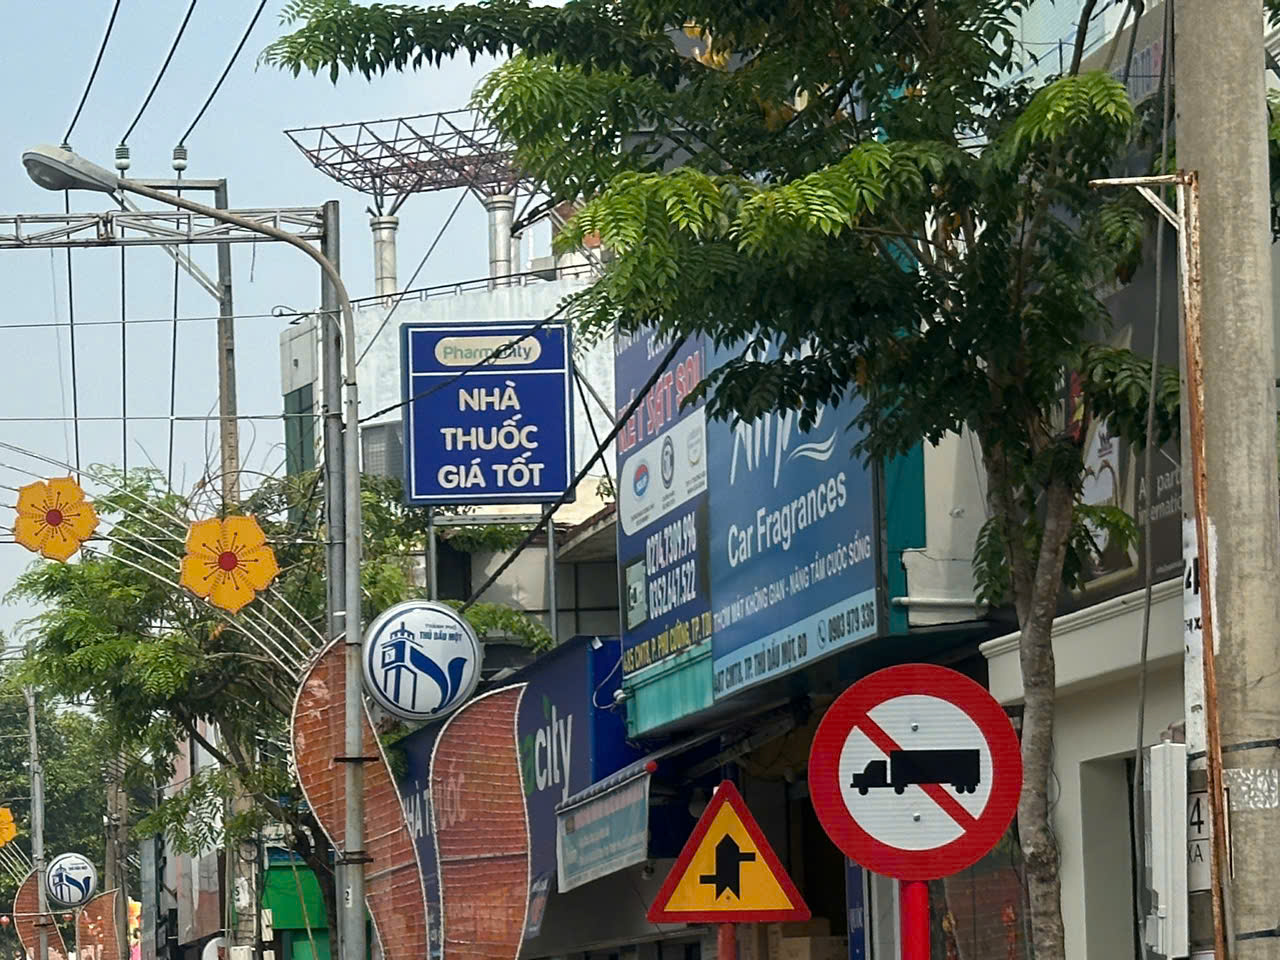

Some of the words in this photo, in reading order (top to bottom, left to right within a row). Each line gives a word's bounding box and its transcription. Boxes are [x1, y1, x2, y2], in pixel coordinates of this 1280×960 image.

[458, 379, 521, 411] NHÀ
[440, 413, 539, 451] THUỐC
[437, 457, 486, 489] GIÁ
[491, 451, 545, 488] TỐT
[728, 524, 753, 568] Car
[756, 472, 847, 552] Fragrances
[1189, 797, 1204, 834] 4
